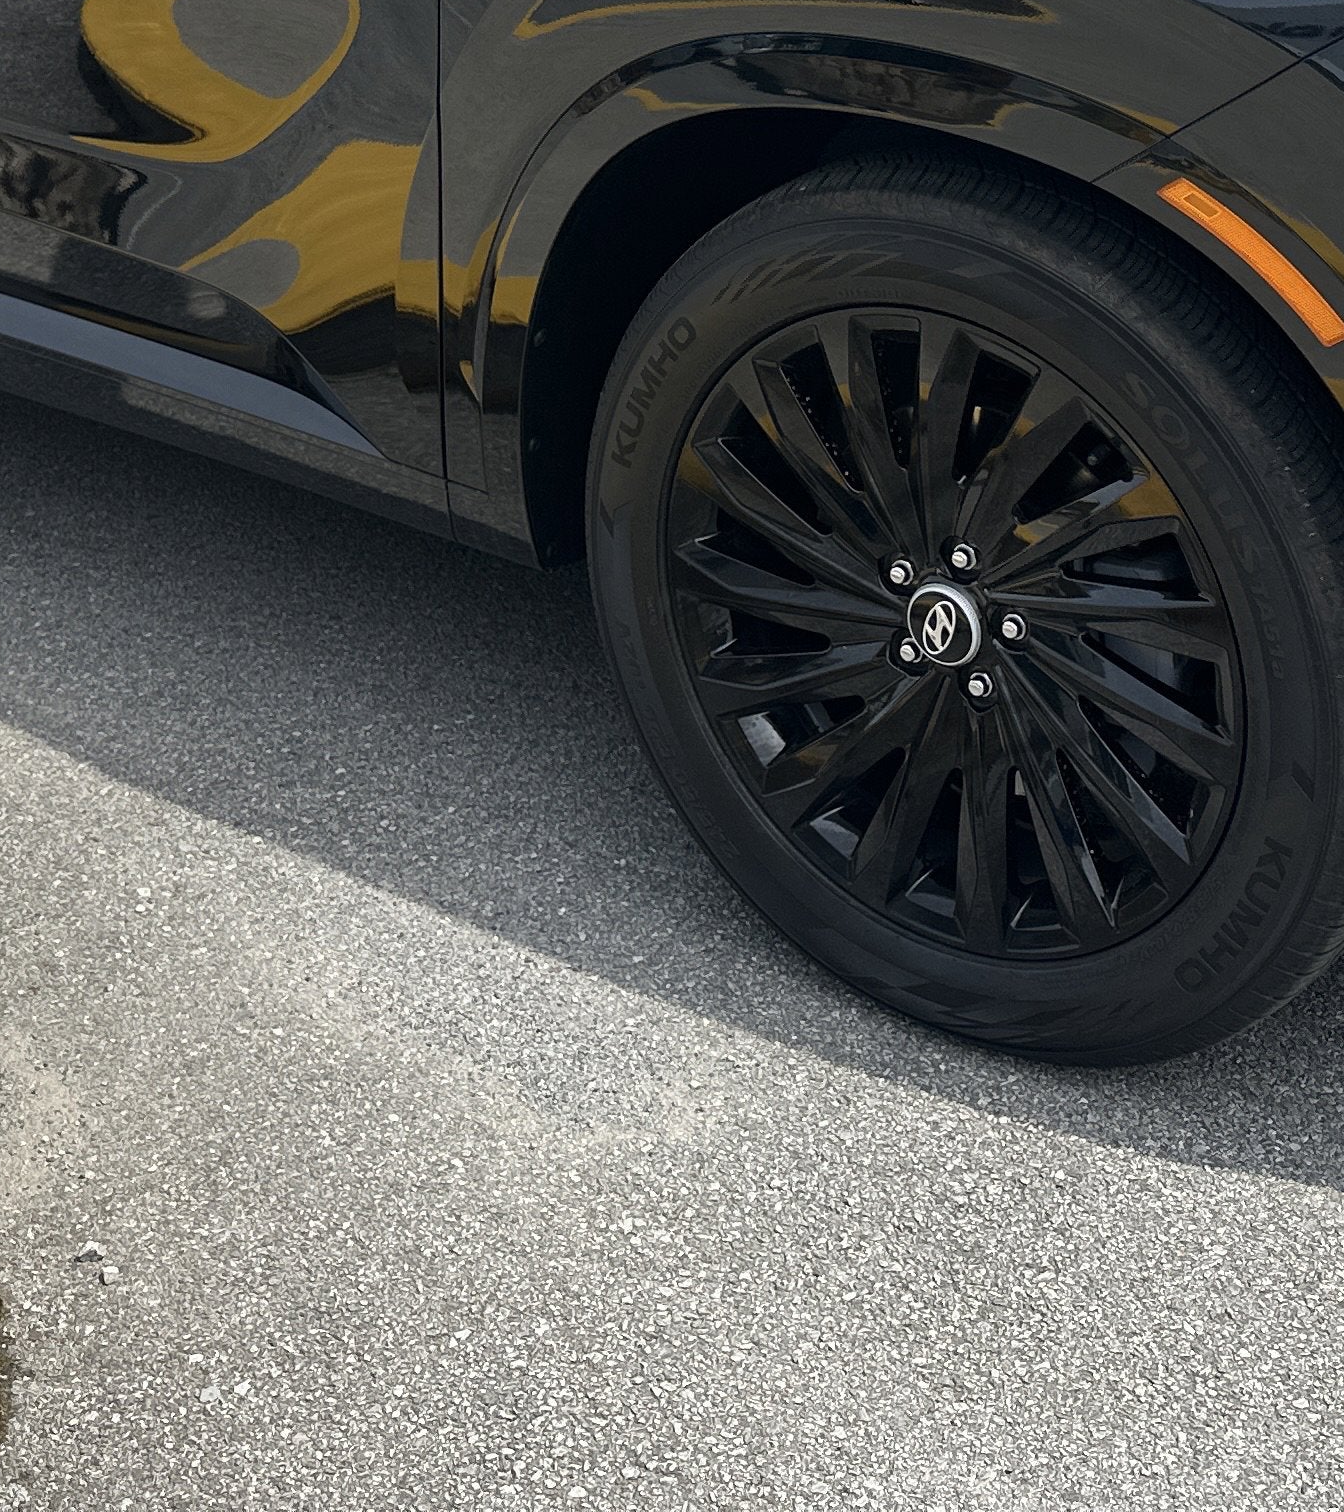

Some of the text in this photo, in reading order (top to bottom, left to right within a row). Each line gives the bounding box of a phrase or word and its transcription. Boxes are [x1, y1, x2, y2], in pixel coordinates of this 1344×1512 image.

[610, 316, 697, 469] KUMHO
[1122, 371, 1263, 575] SOLUS
[1174, 836, 1294, 994] KUMHO
